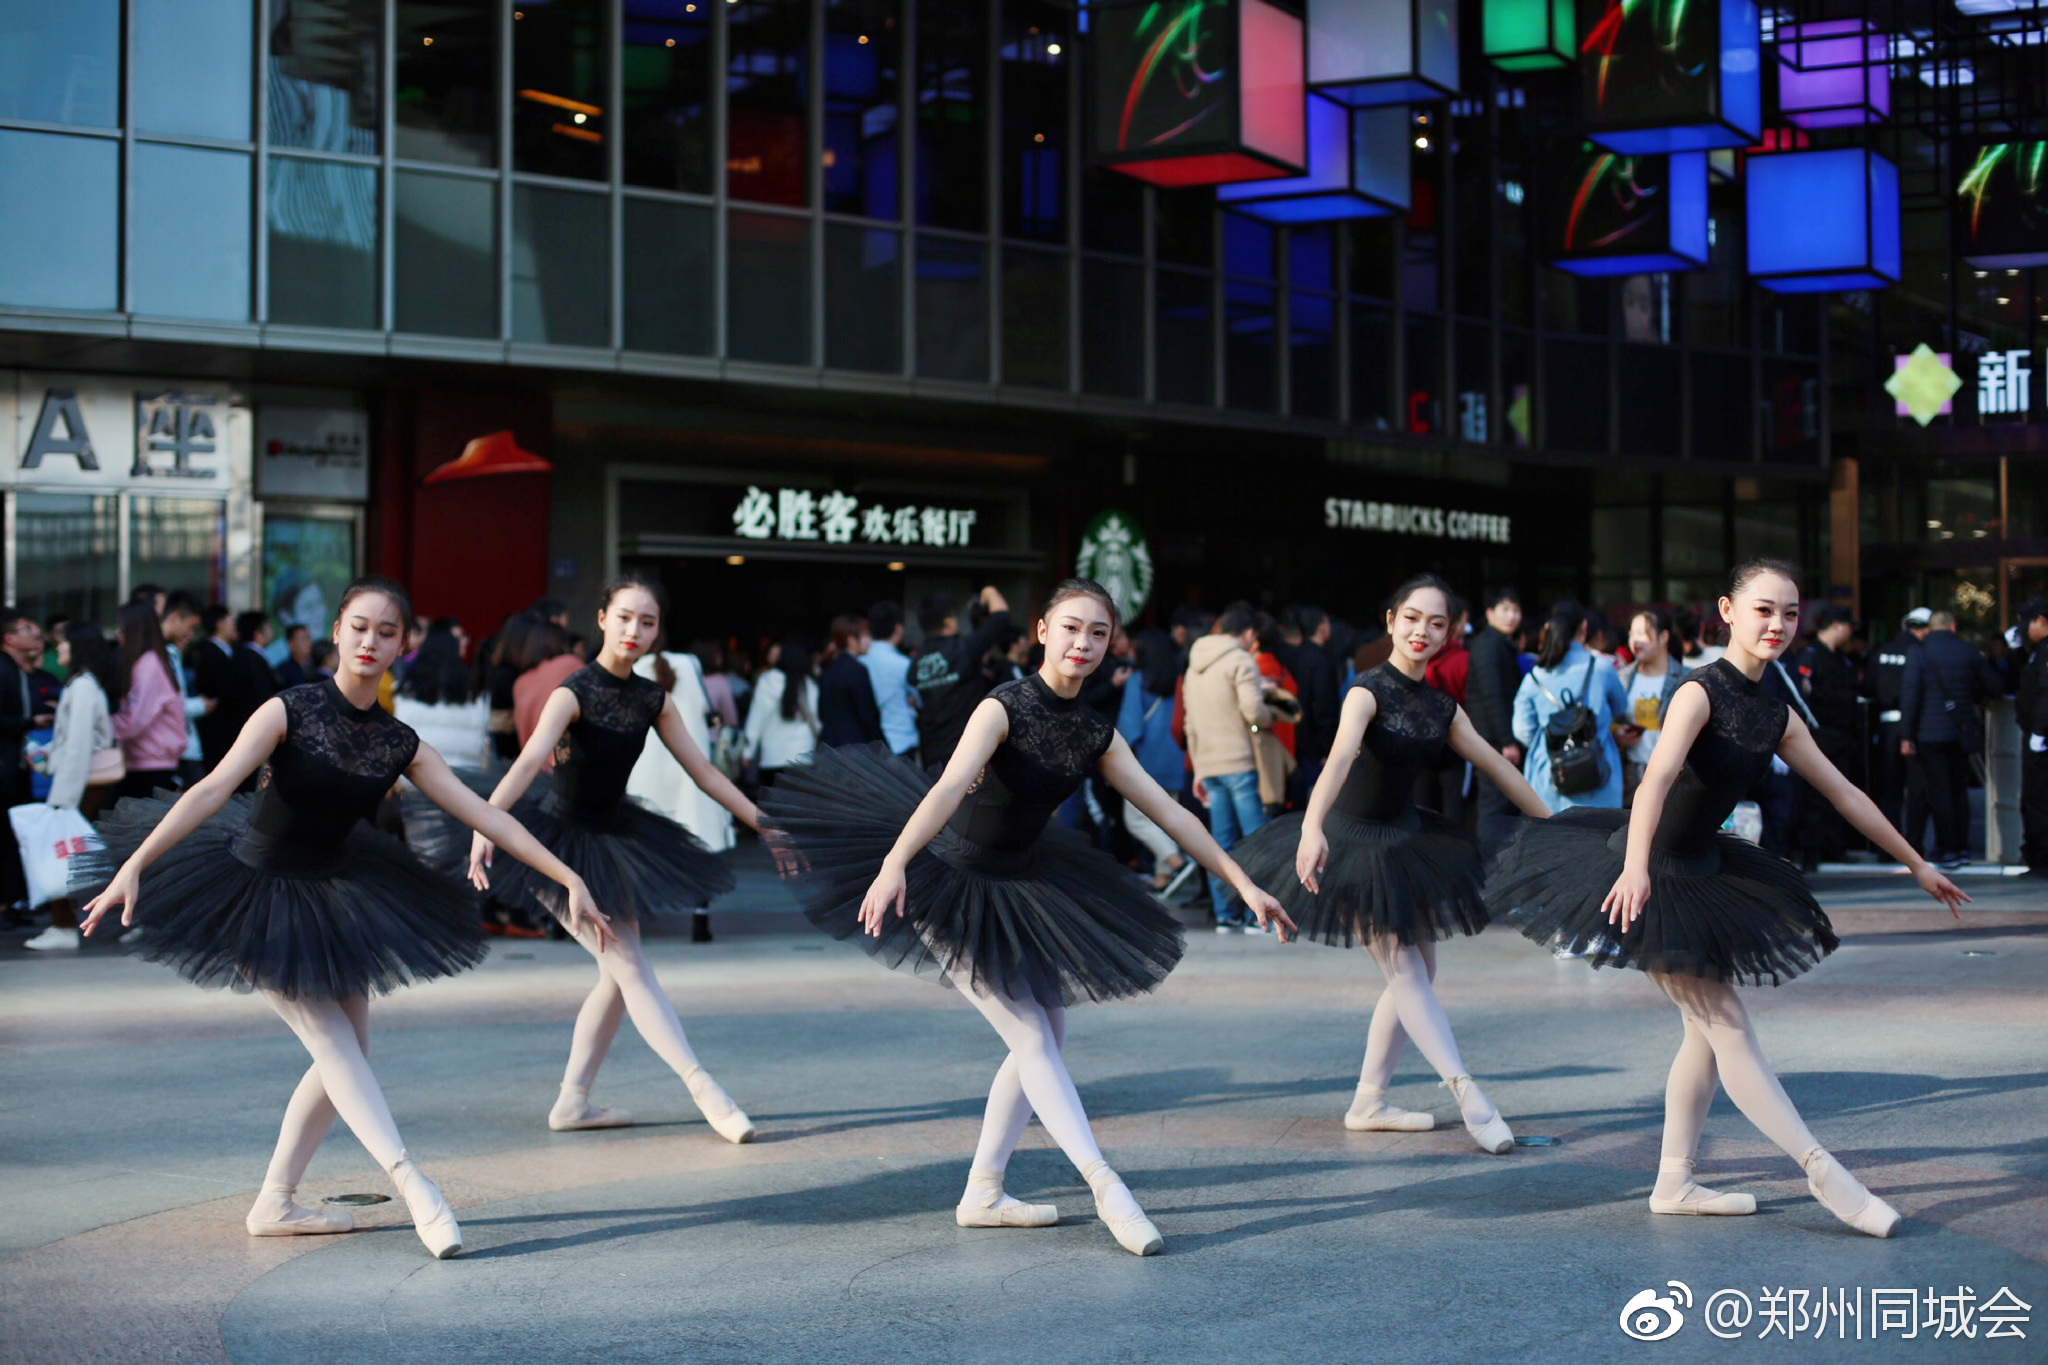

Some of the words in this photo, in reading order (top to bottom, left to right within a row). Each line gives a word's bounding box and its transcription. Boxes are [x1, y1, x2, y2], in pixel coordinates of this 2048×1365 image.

[1978, 349, 2048, 414] 新
[732, 486, 858, 545] 必胜客
[861, 504, 977, 548] 欢乐餐厅
[1324, 497, 1445, 537] STARBUCKS
[1446, 509, 1511, 544] COFFEE
